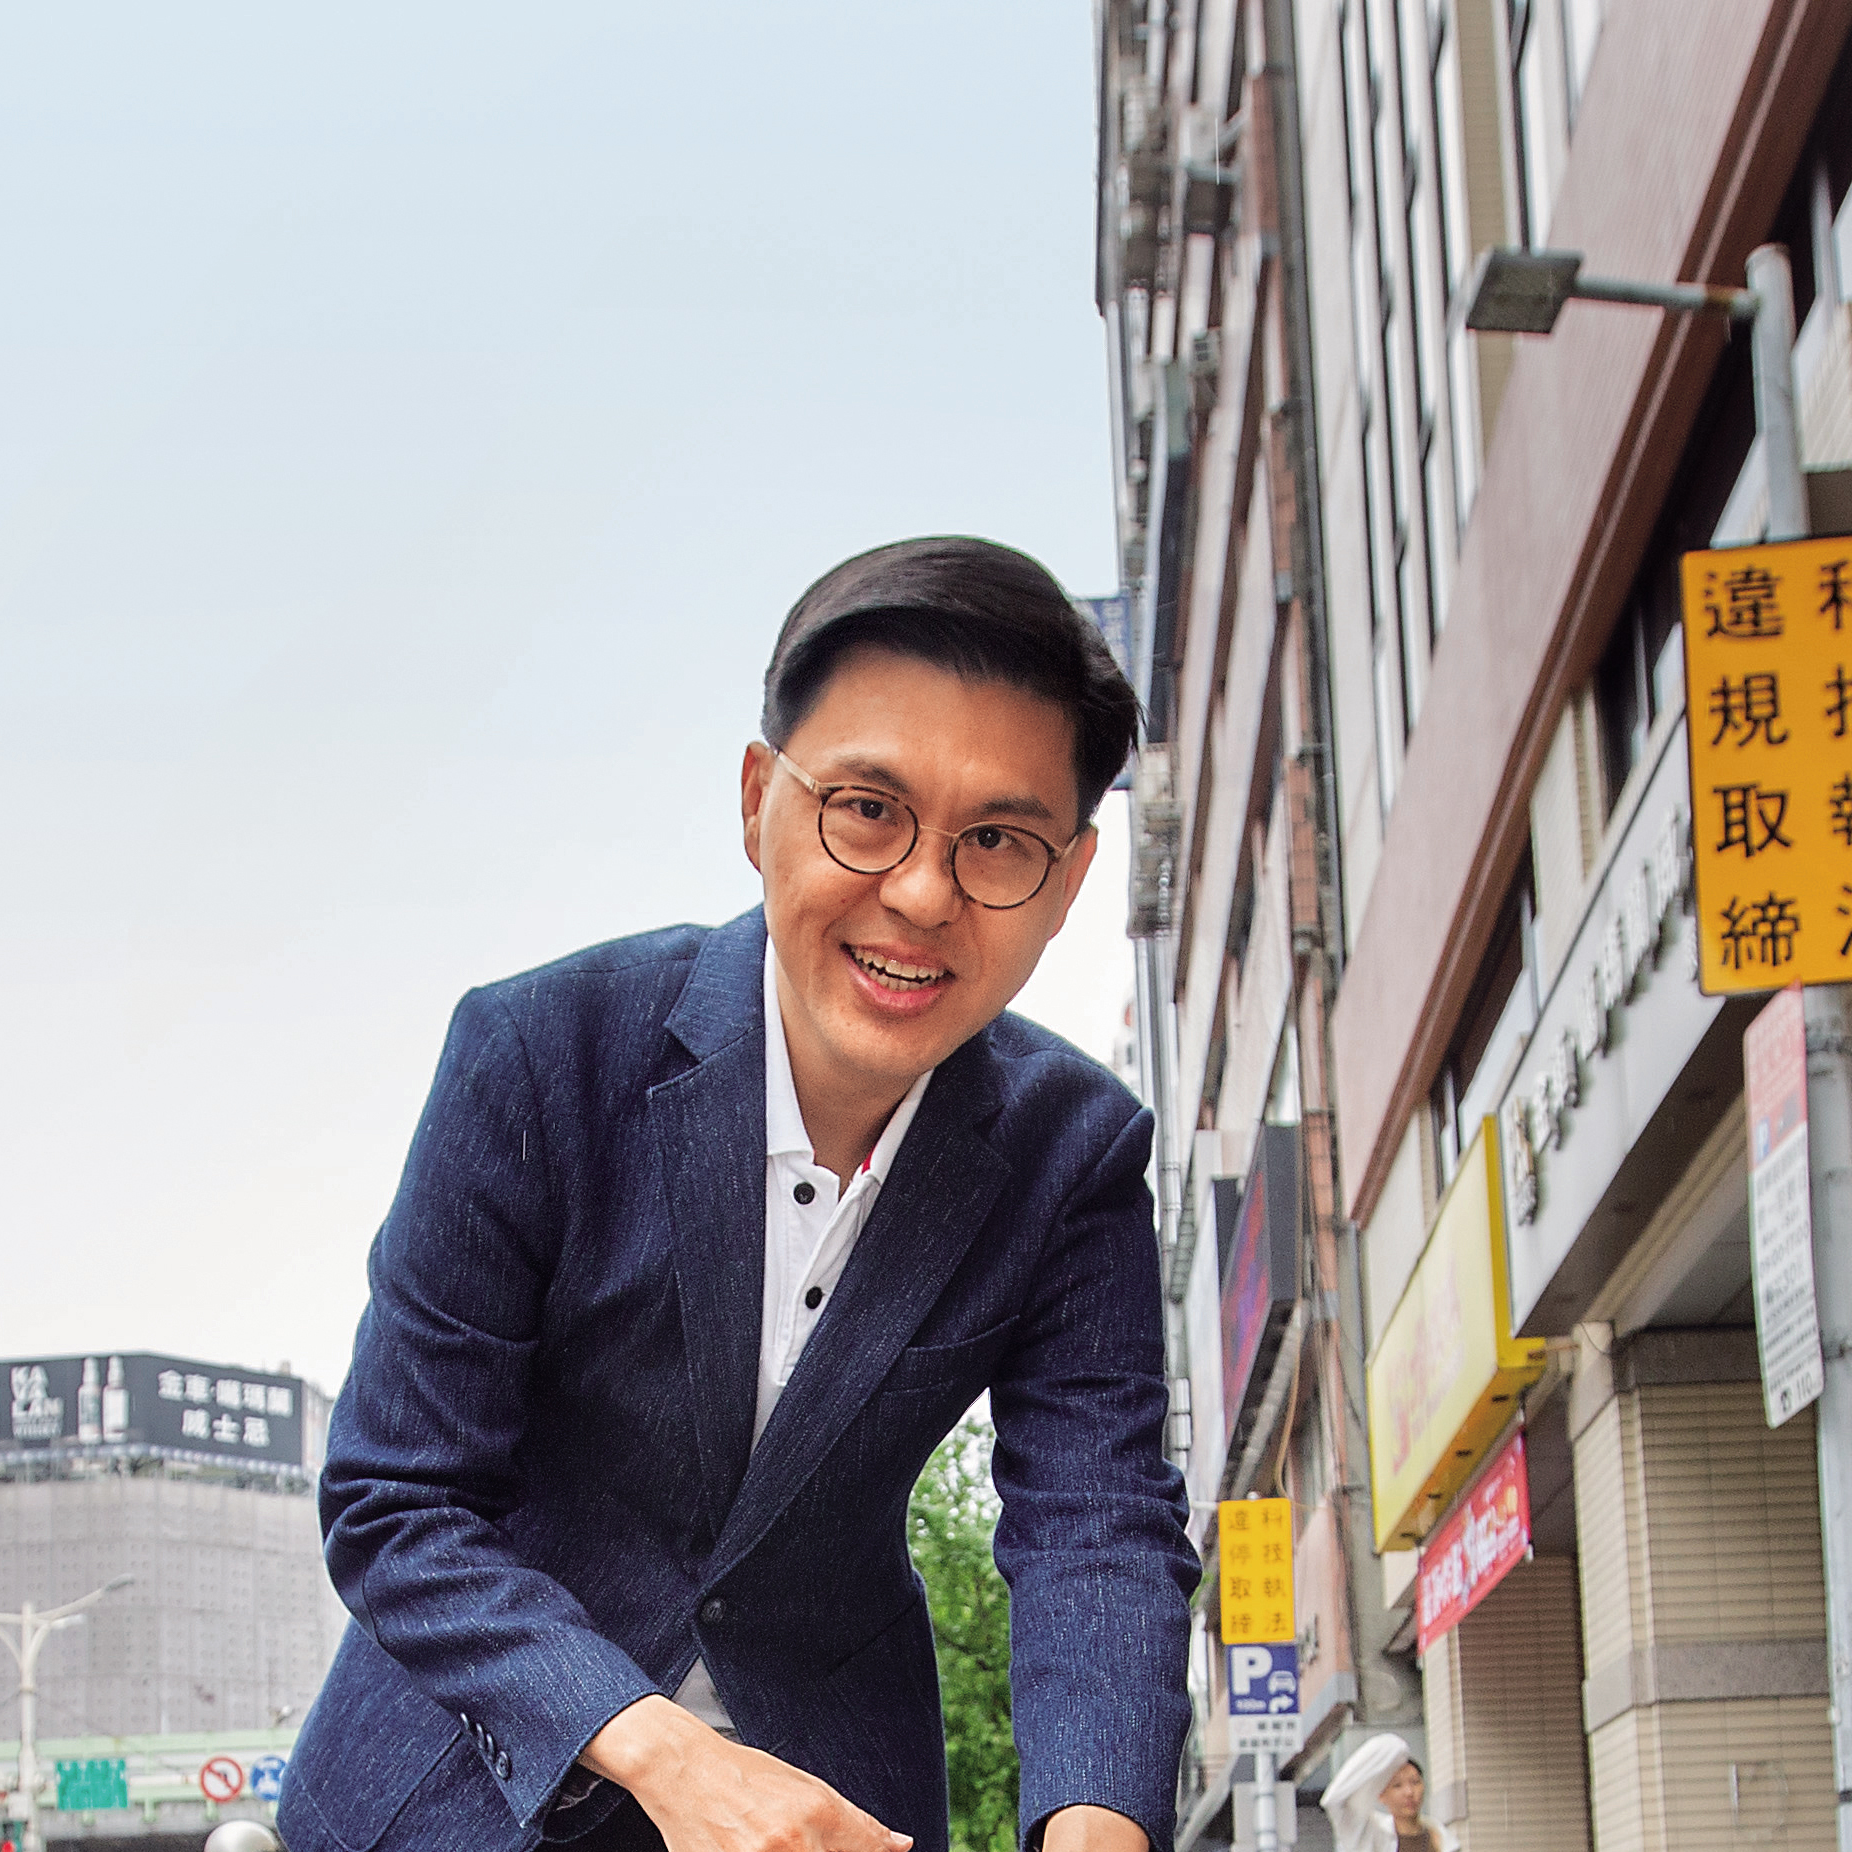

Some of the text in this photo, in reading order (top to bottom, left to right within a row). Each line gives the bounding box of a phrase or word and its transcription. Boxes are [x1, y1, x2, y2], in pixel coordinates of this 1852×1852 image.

[1704, 564, 1801, 971] 違規取締
[1231, 1646, 1273, 1696] P
